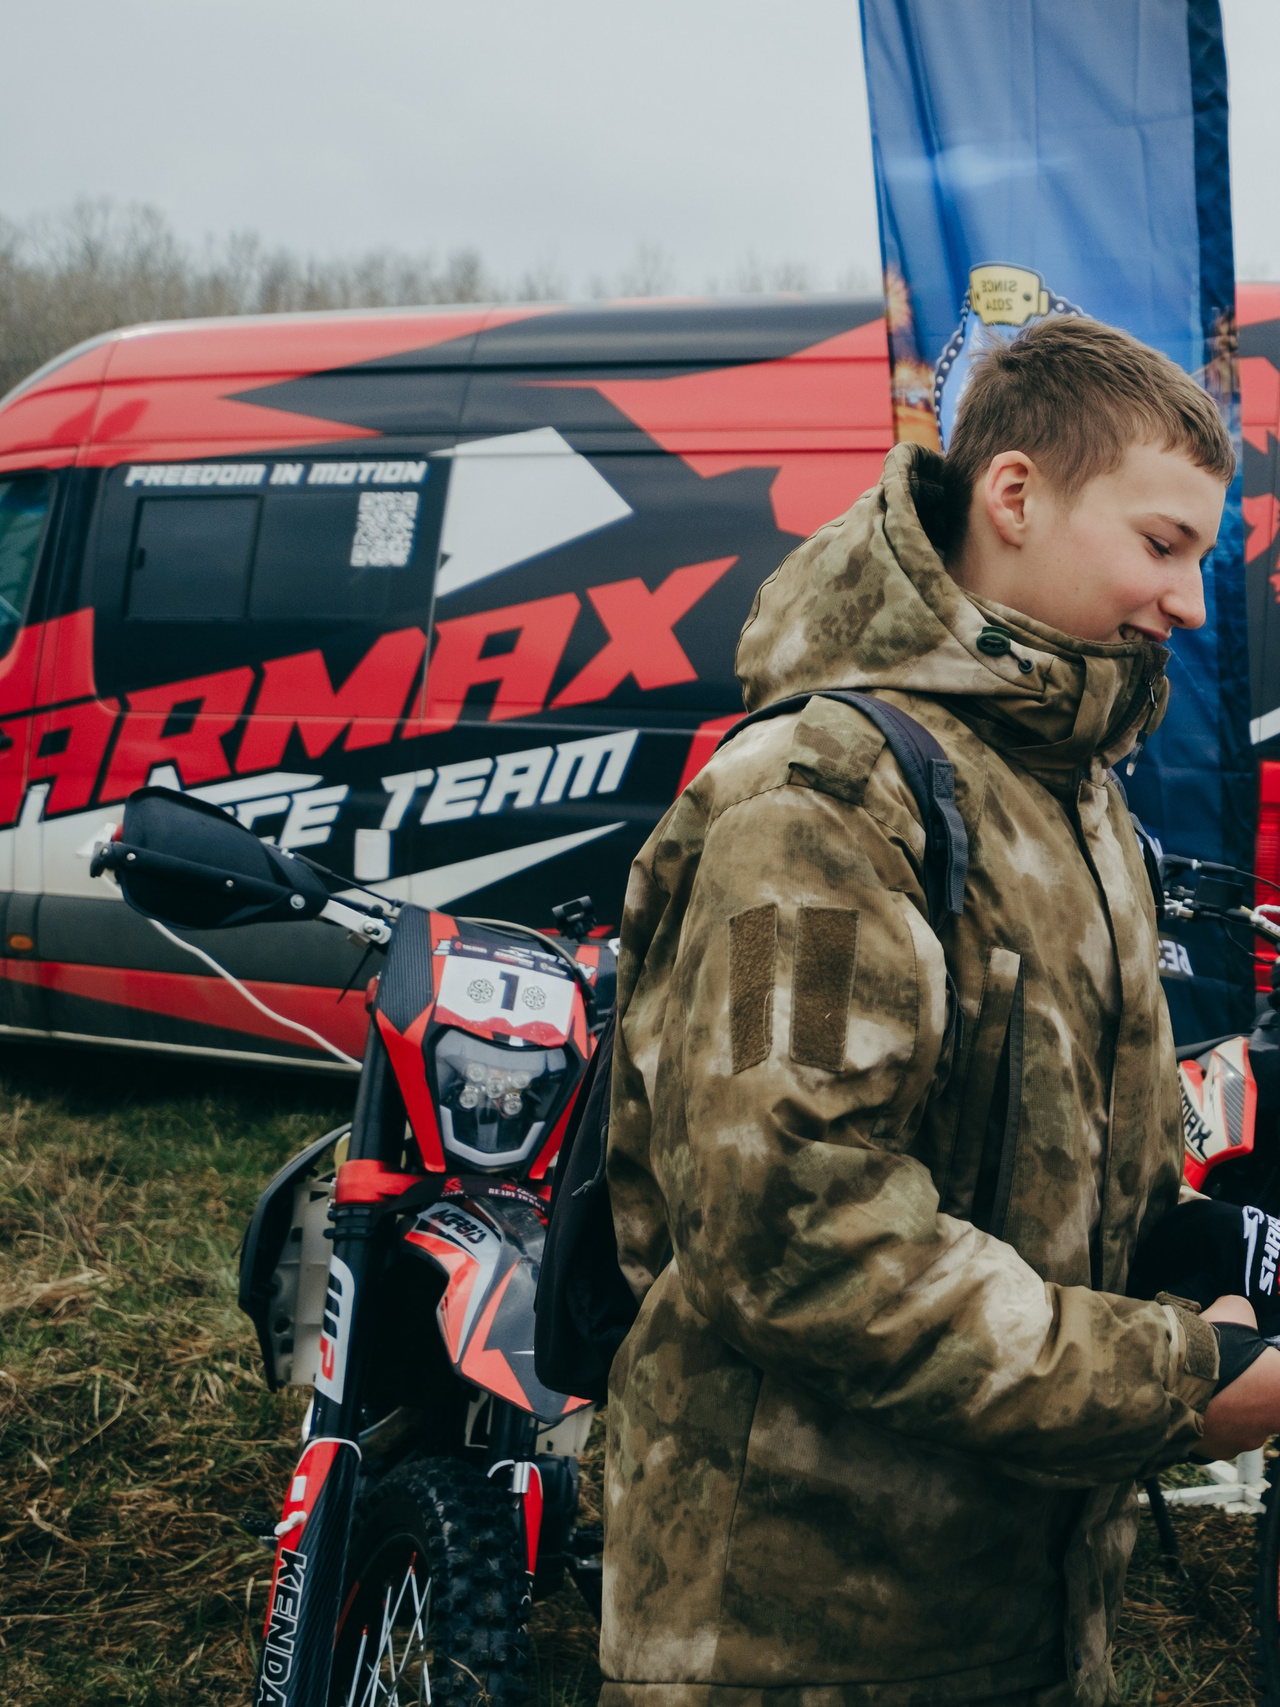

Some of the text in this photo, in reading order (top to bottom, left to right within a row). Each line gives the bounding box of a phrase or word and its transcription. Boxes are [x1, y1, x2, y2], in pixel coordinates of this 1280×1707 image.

[124, 461, 428, 487] FREEDOM IN MOTION
[380, 729, 639, 833] TEAM
[499, 970, 520, 1012] 1
[257, 1547, 308, 1707] KENDA
